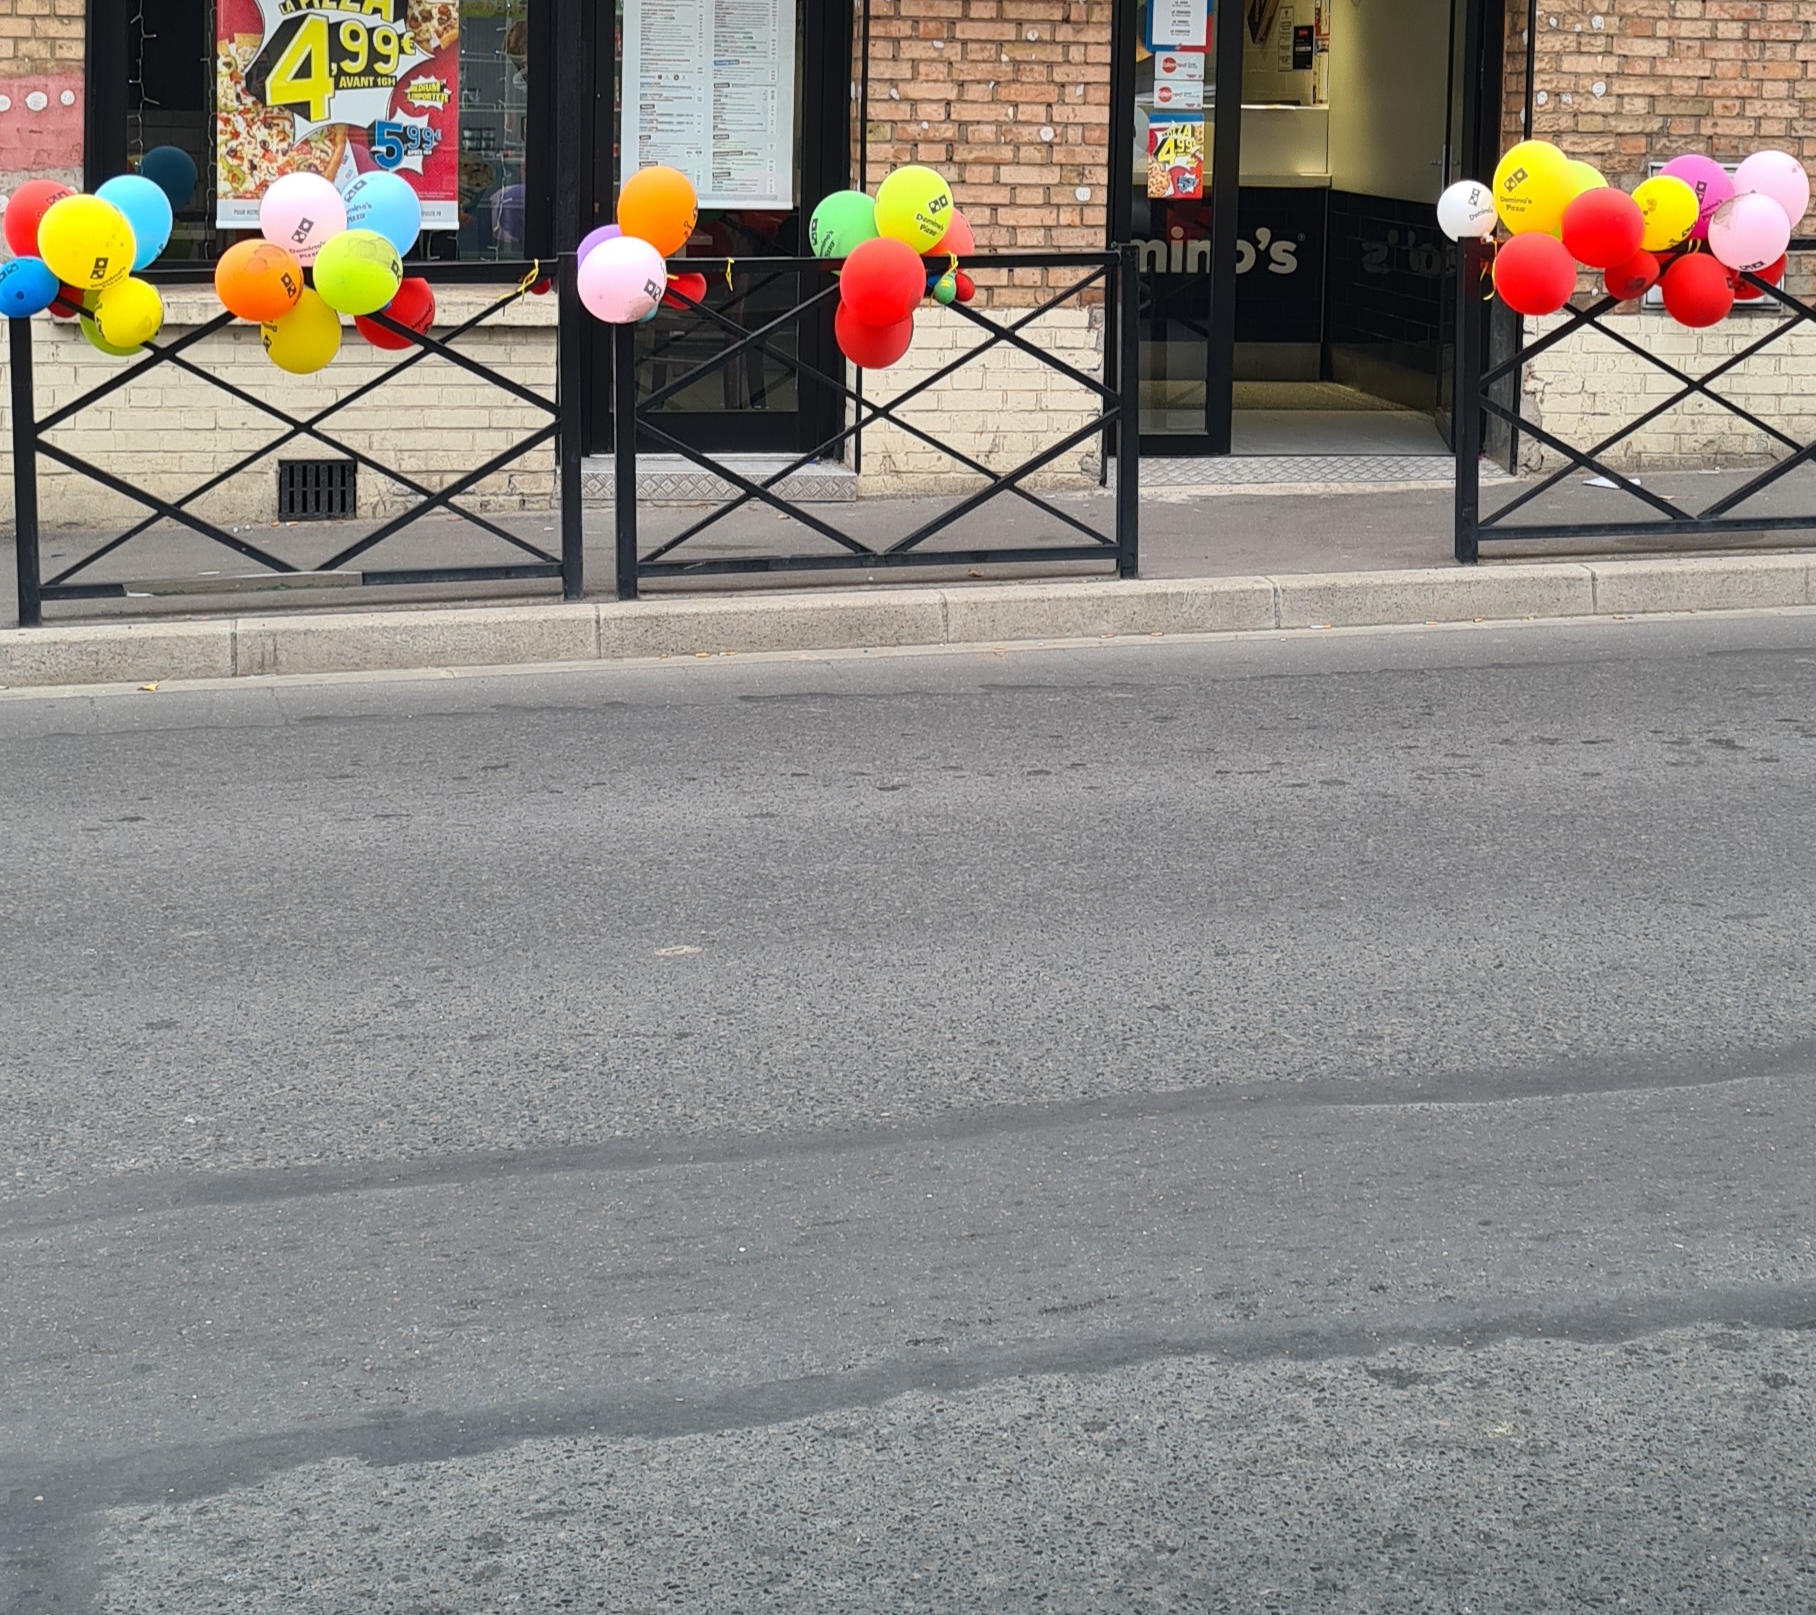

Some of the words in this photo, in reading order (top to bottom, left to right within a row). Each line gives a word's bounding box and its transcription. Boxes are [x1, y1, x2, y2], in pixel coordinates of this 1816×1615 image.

[279, 1, 296, 16] LA
[338, 76, 374, 89] AVANT
[376, 75, 396, 87] 16H
[1500, 196, 1533, 205] Domino's
[346, 201, 373, 215] mino's
[915, 212, 945, 233] Domino's
